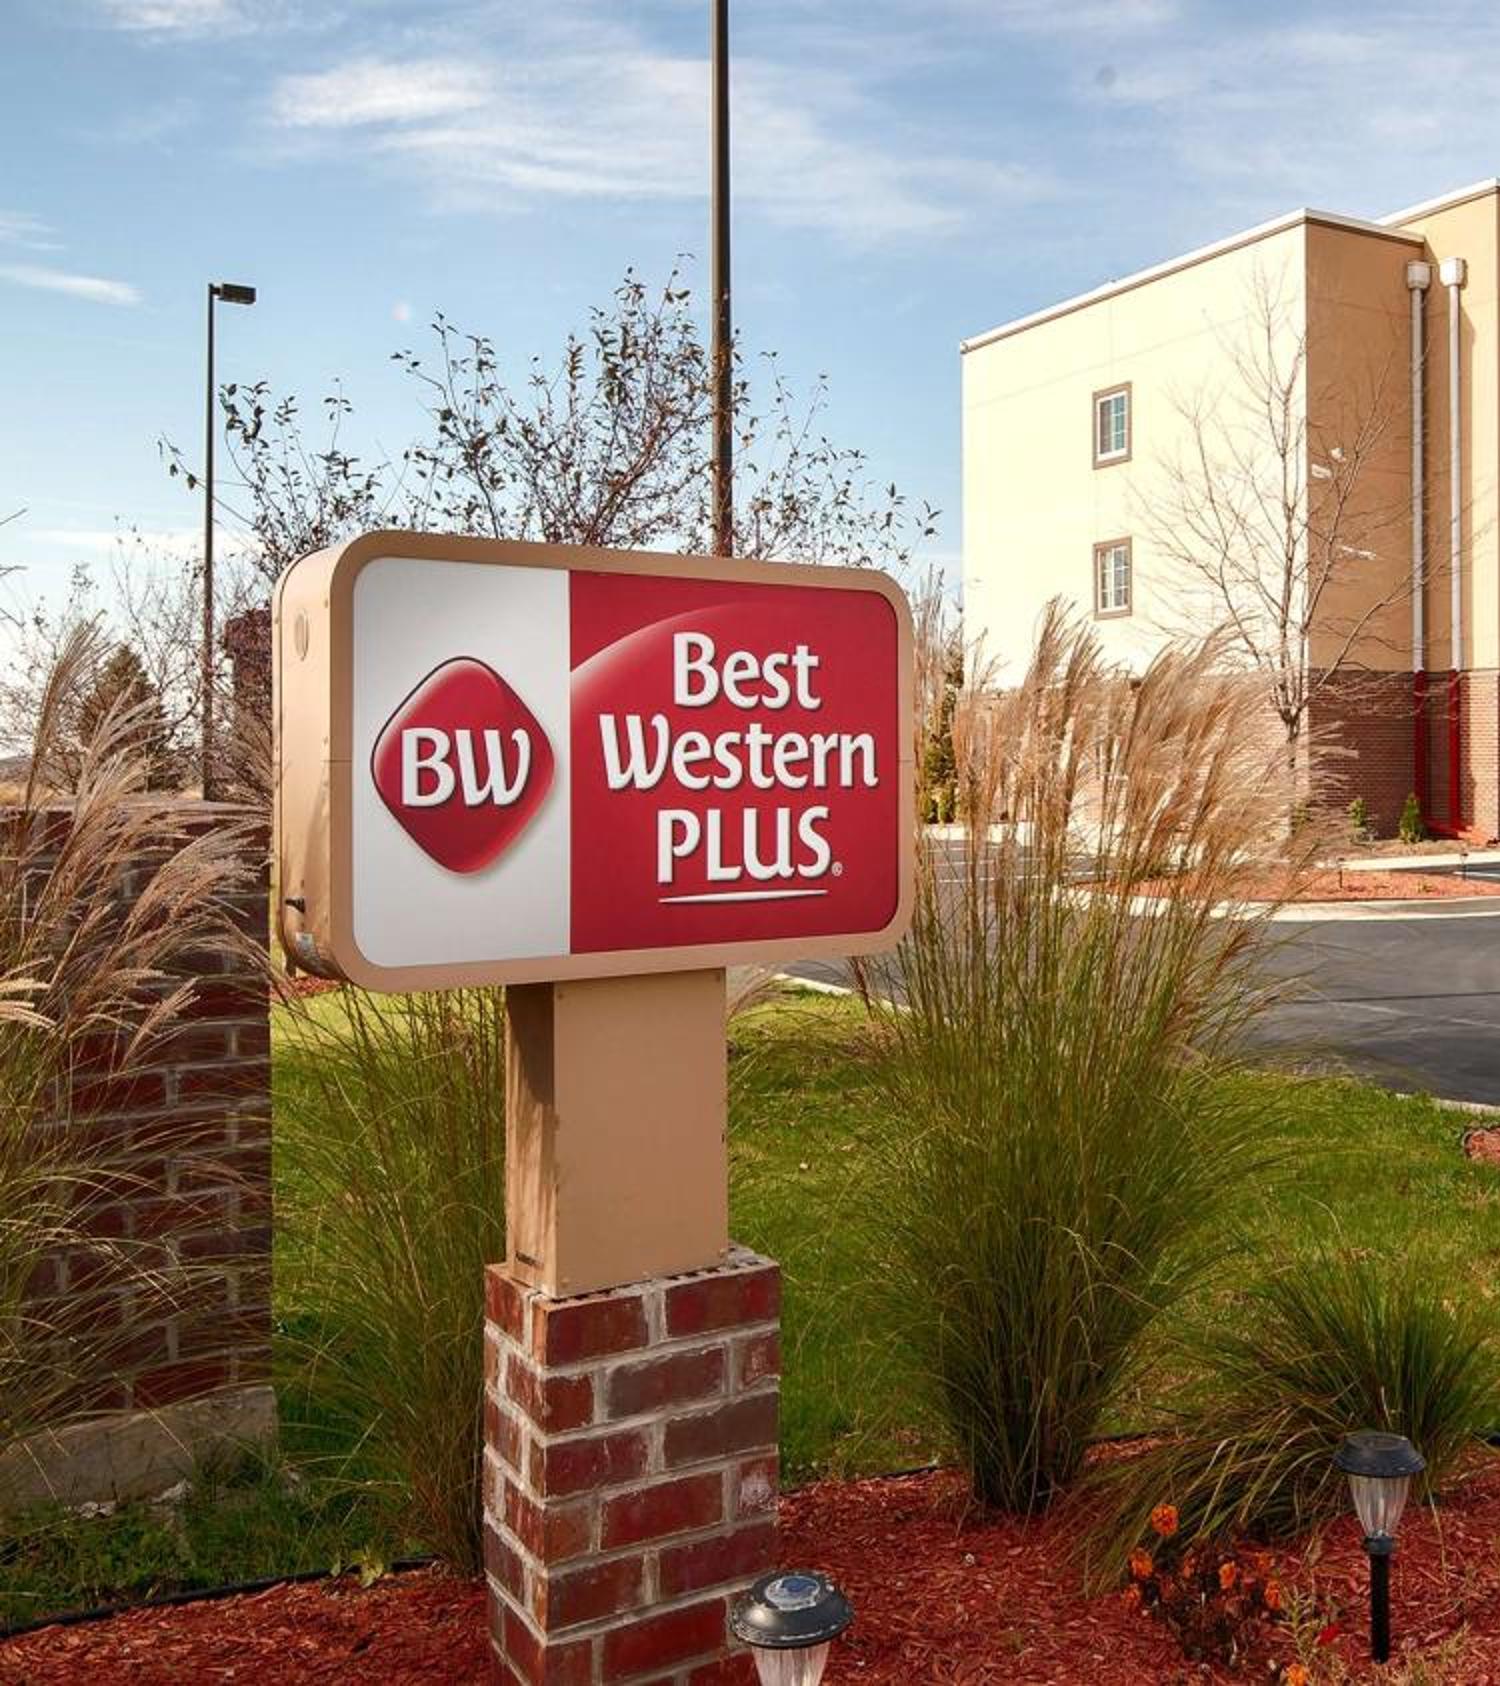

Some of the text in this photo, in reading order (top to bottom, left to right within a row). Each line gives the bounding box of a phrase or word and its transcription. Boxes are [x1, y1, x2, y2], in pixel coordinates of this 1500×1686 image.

[673, 631, 821, 709] Best
[401, 727, 531, 807] BW
[599, 713, 879, 790] Western
[657, 805, 832, 884] PLUS
